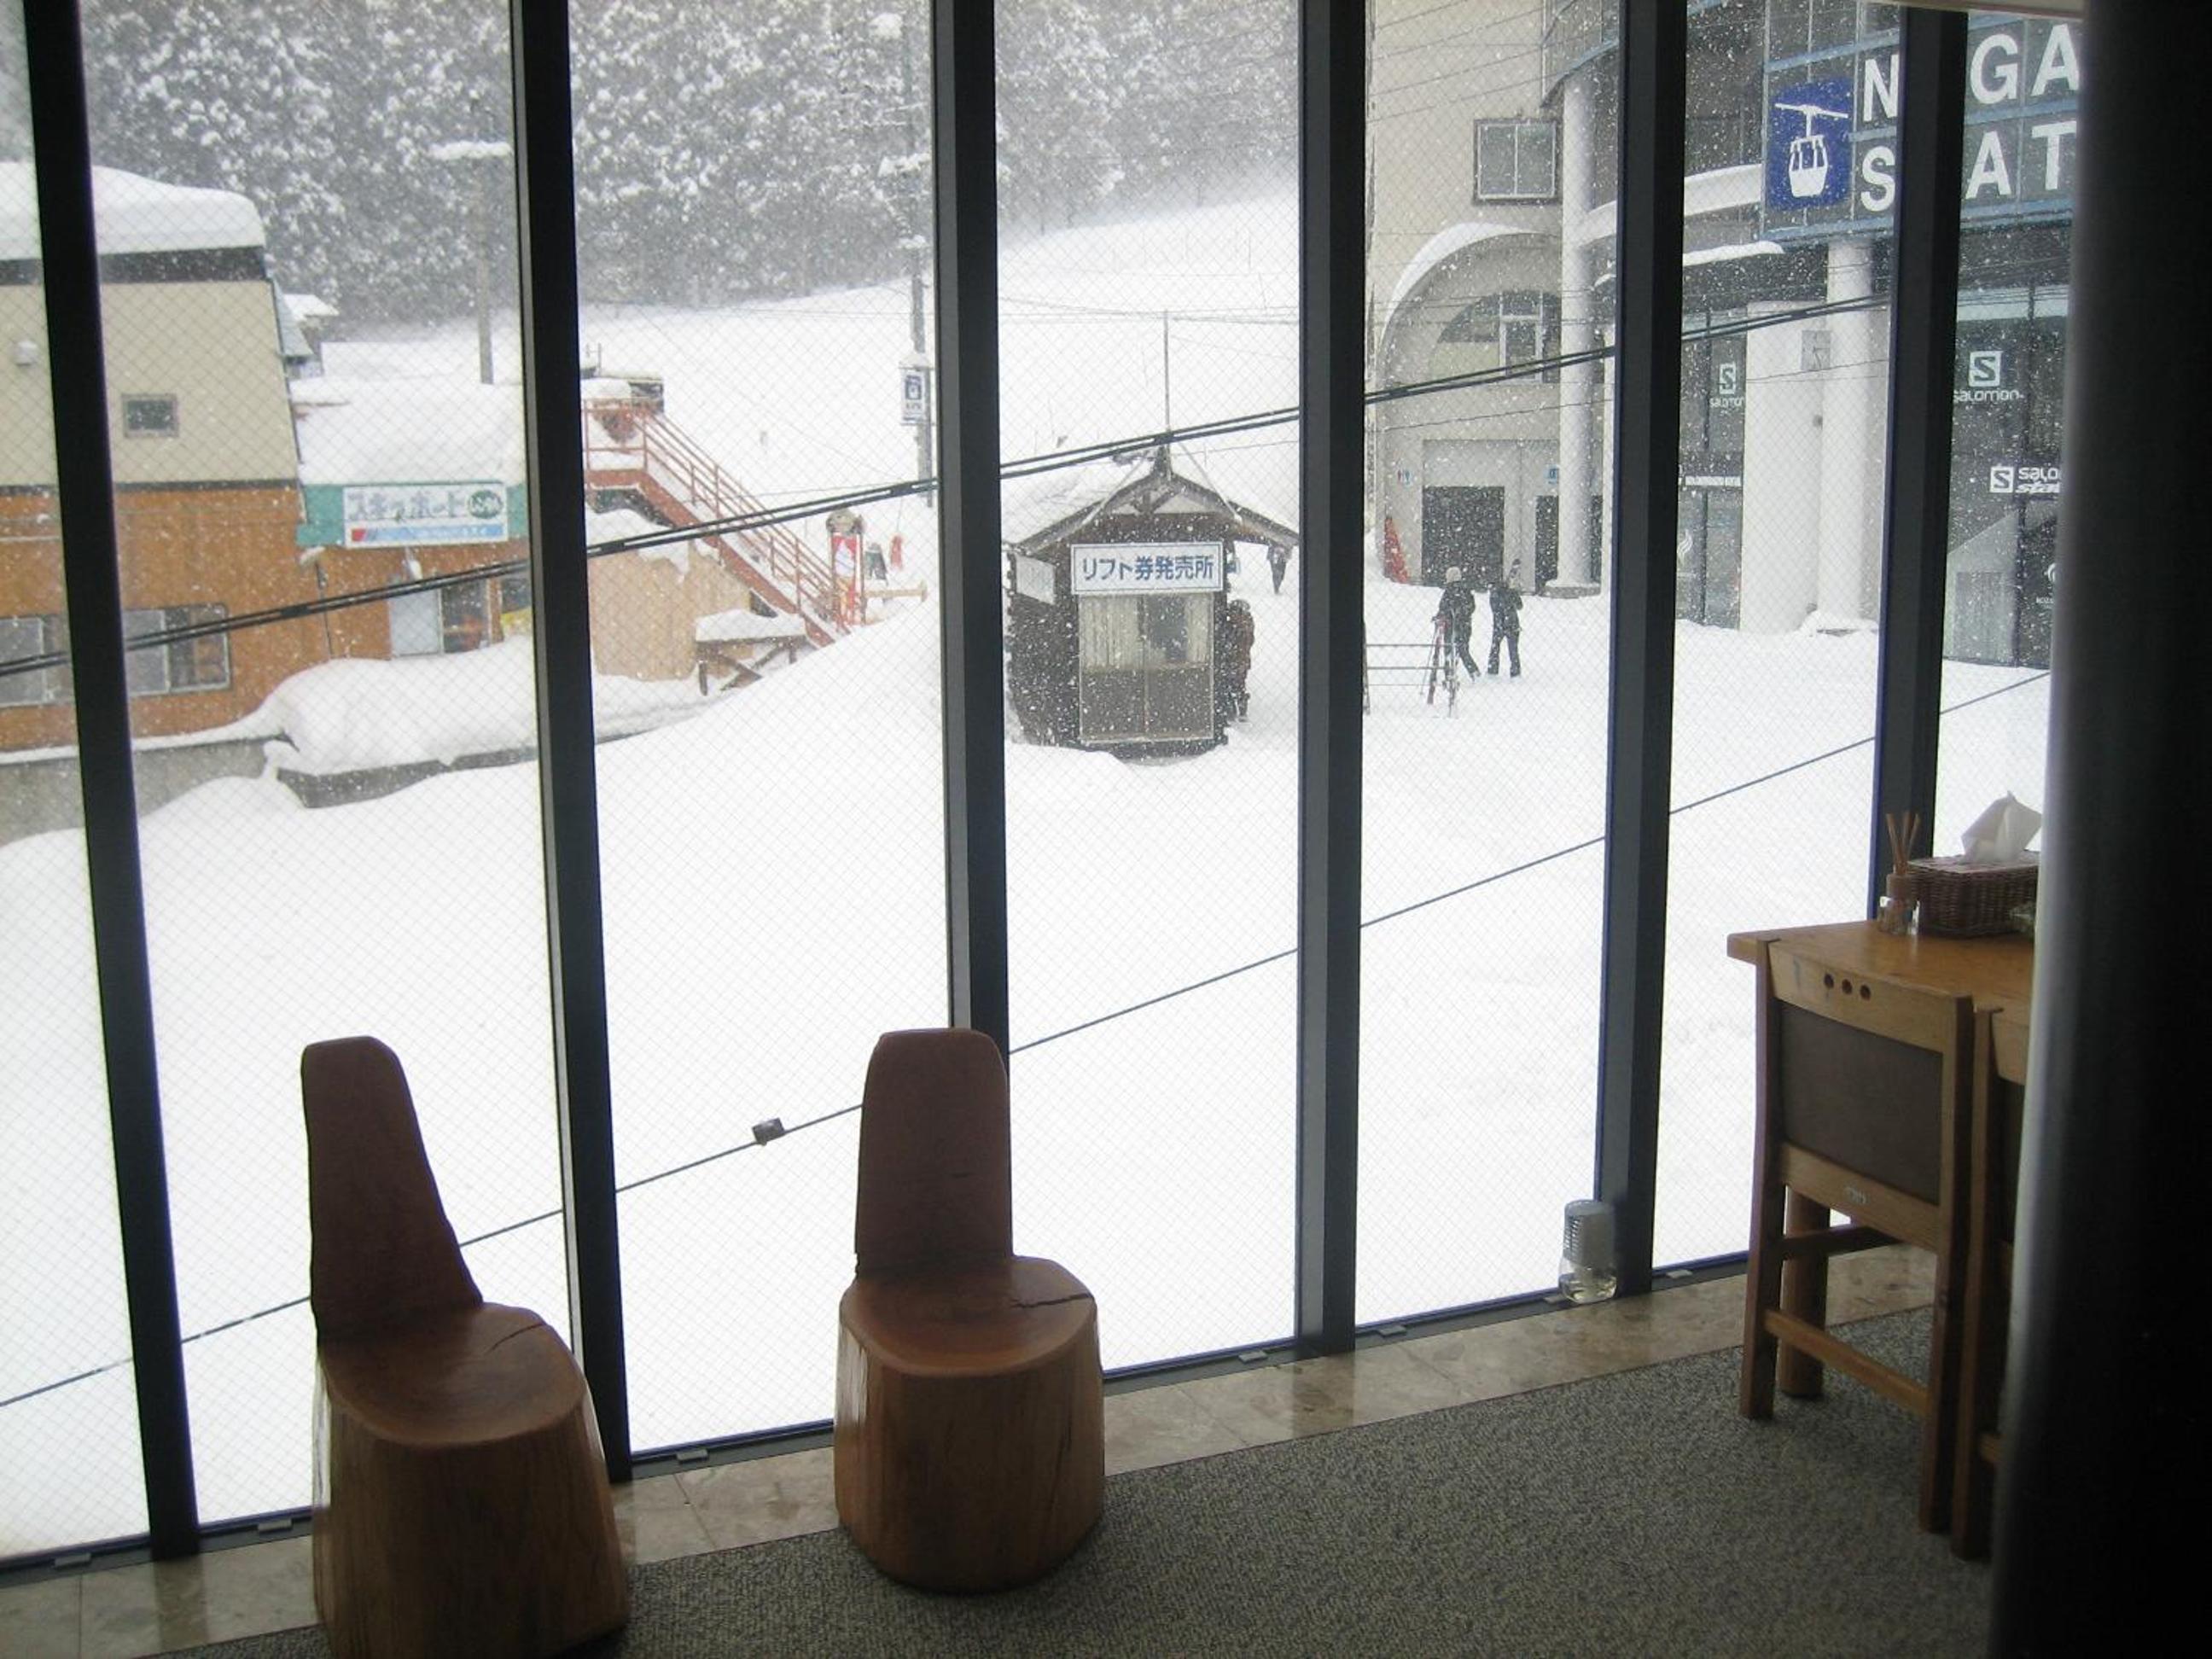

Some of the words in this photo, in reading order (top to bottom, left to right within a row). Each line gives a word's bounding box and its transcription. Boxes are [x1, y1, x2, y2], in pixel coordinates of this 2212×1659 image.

[1083, 556, 1215, 581] リフト券発売所
